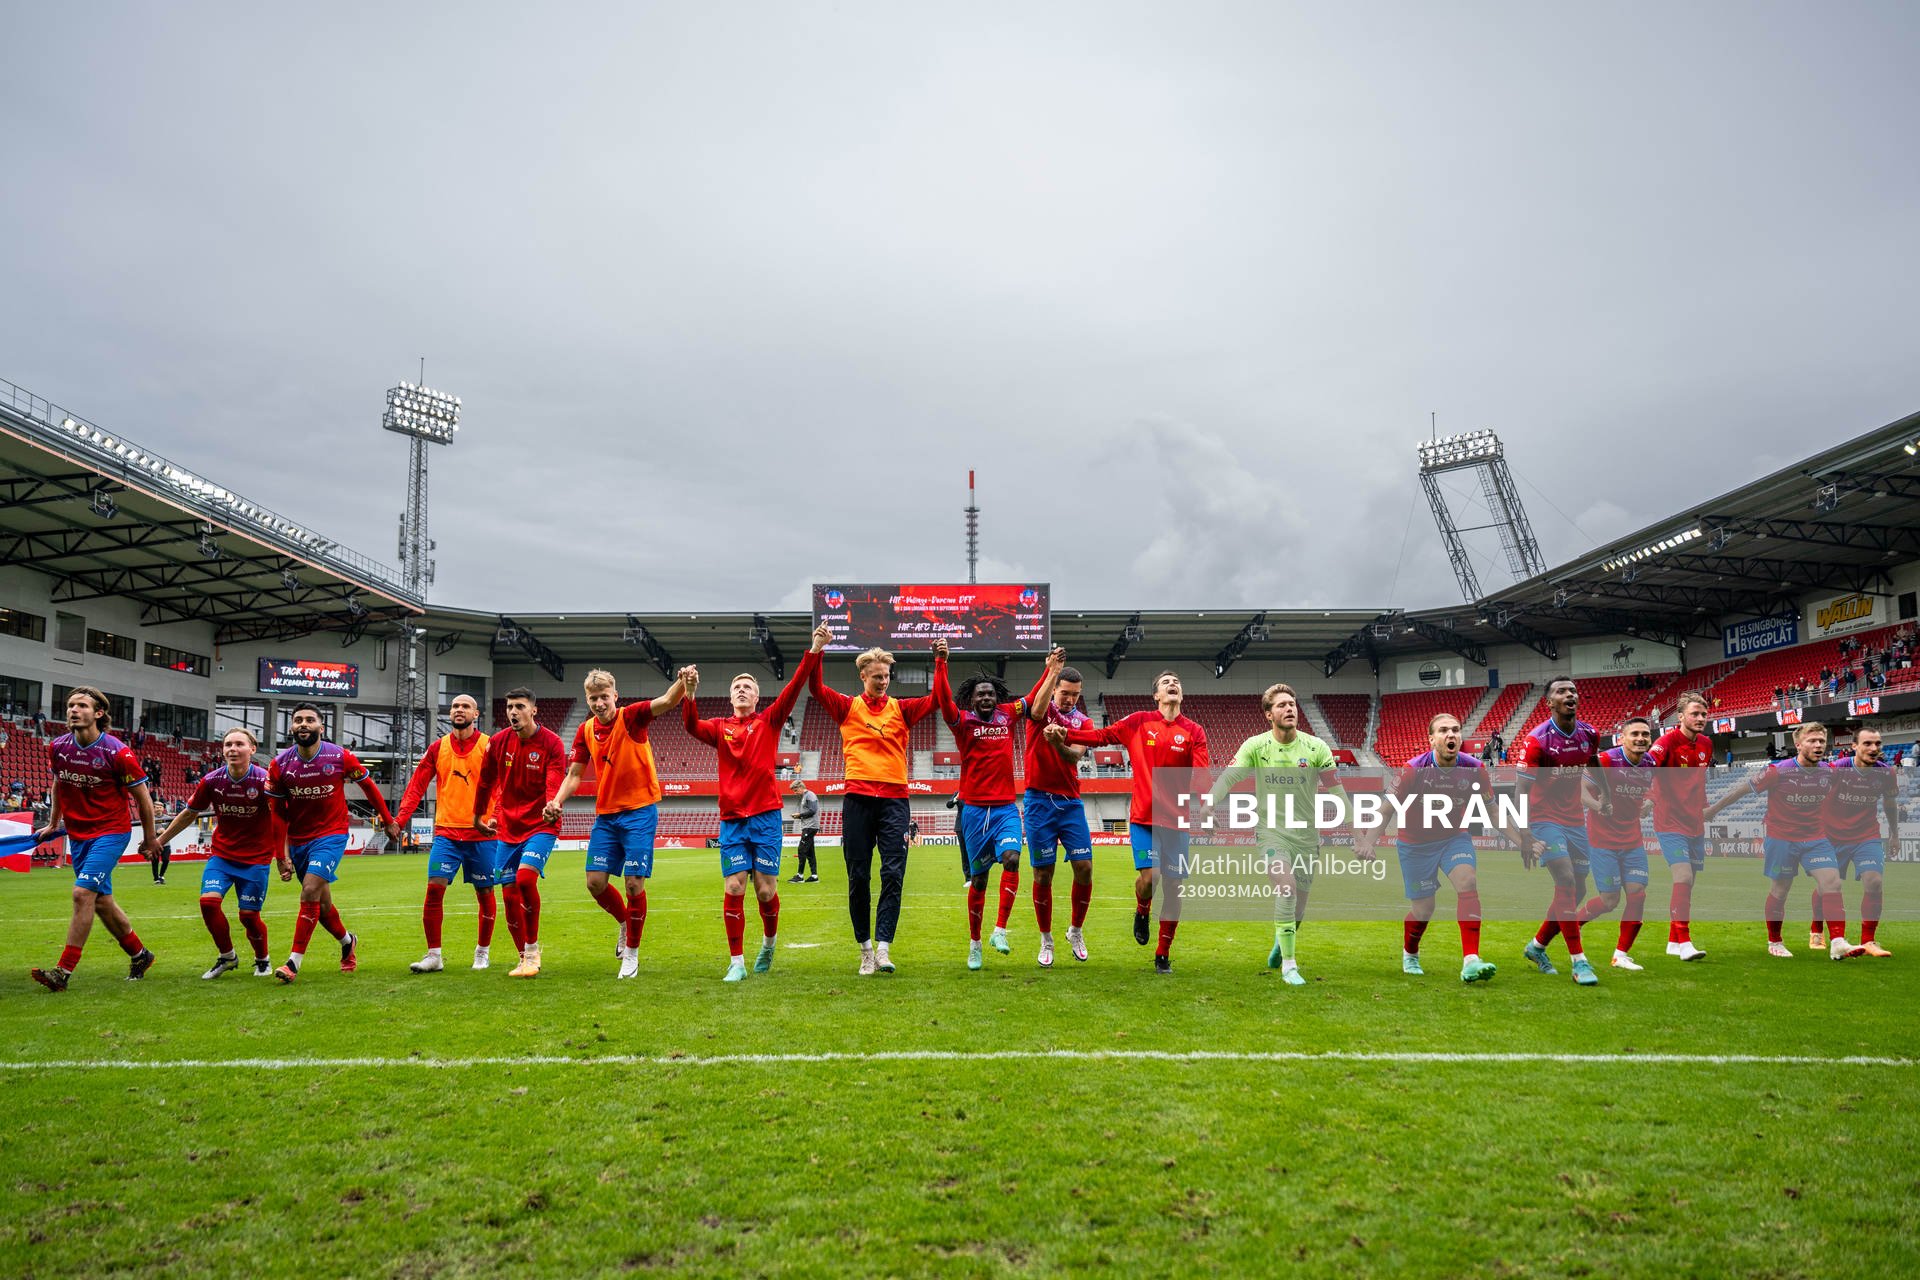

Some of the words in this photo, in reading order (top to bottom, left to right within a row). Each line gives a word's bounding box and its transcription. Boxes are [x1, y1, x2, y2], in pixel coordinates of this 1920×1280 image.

[1817, 594, 1874, 630] WALLIN
[1740, 624, 1793, 652] BYGGPLÅT
[281, 666, 302, 676] TACK
[974, 726, 1003, 737] akea
[1552, 764, 1579, 775] akea
[60, 769, 87, 782] akea
[1265, 773, 1294, 784] akea
[289, 785, 320, 796] akea
[664, 783, 684, 791] akea
[908, 781, 932, 792] MLÖSA
[1616, 783, 1642, 794] akea
[1787, 793, 1816, 803] akea
[1838, 792, 1867, 803] akea
[1719, 842, 1736, 854] TACK
